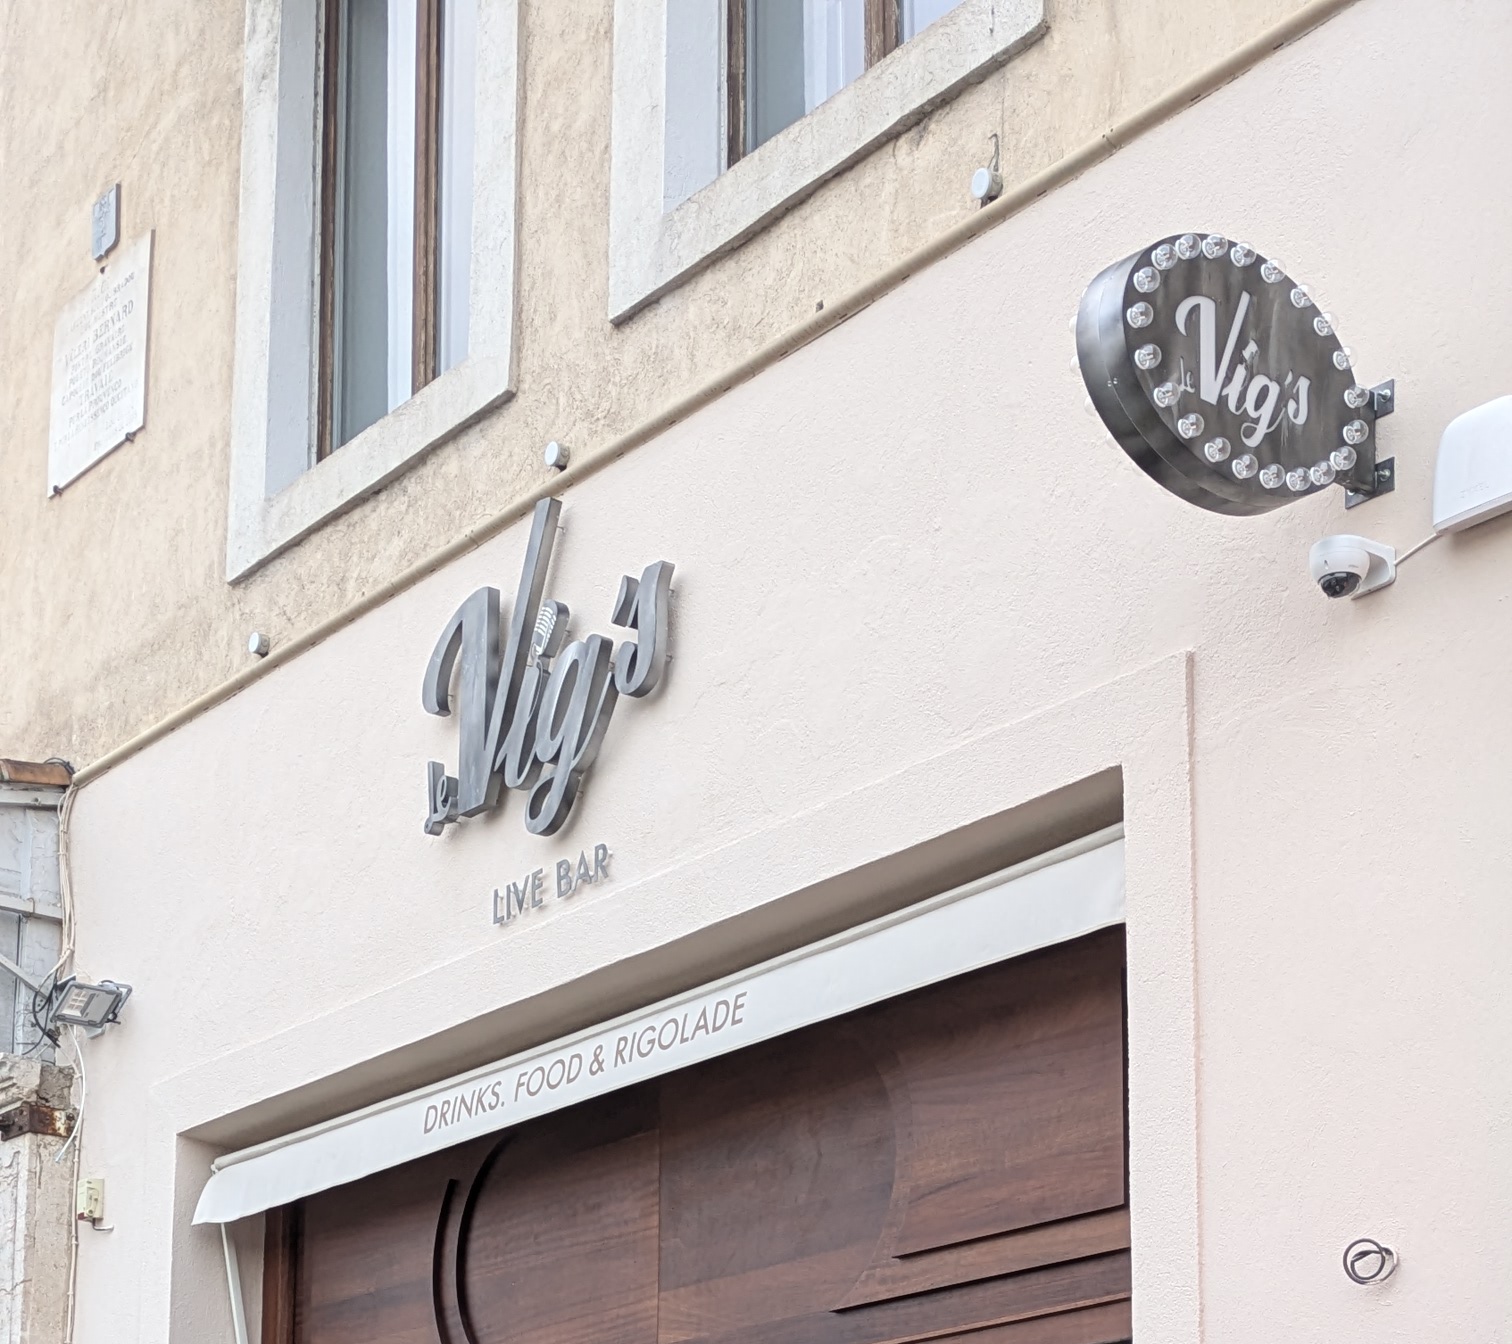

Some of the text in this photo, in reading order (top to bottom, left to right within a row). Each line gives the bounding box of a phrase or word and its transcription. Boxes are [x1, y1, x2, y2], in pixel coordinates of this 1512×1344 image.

[1174, 290, 1310, 448] Vig's
[422, 497, 675, 837] Vig's
[492, 843, 610, 925] LIVE BAR
[514, 1053, 583, 1102] FOOD
[589, 1044, 605, 1077] &
[614, 991, 747, 1068] RIGOLADE
